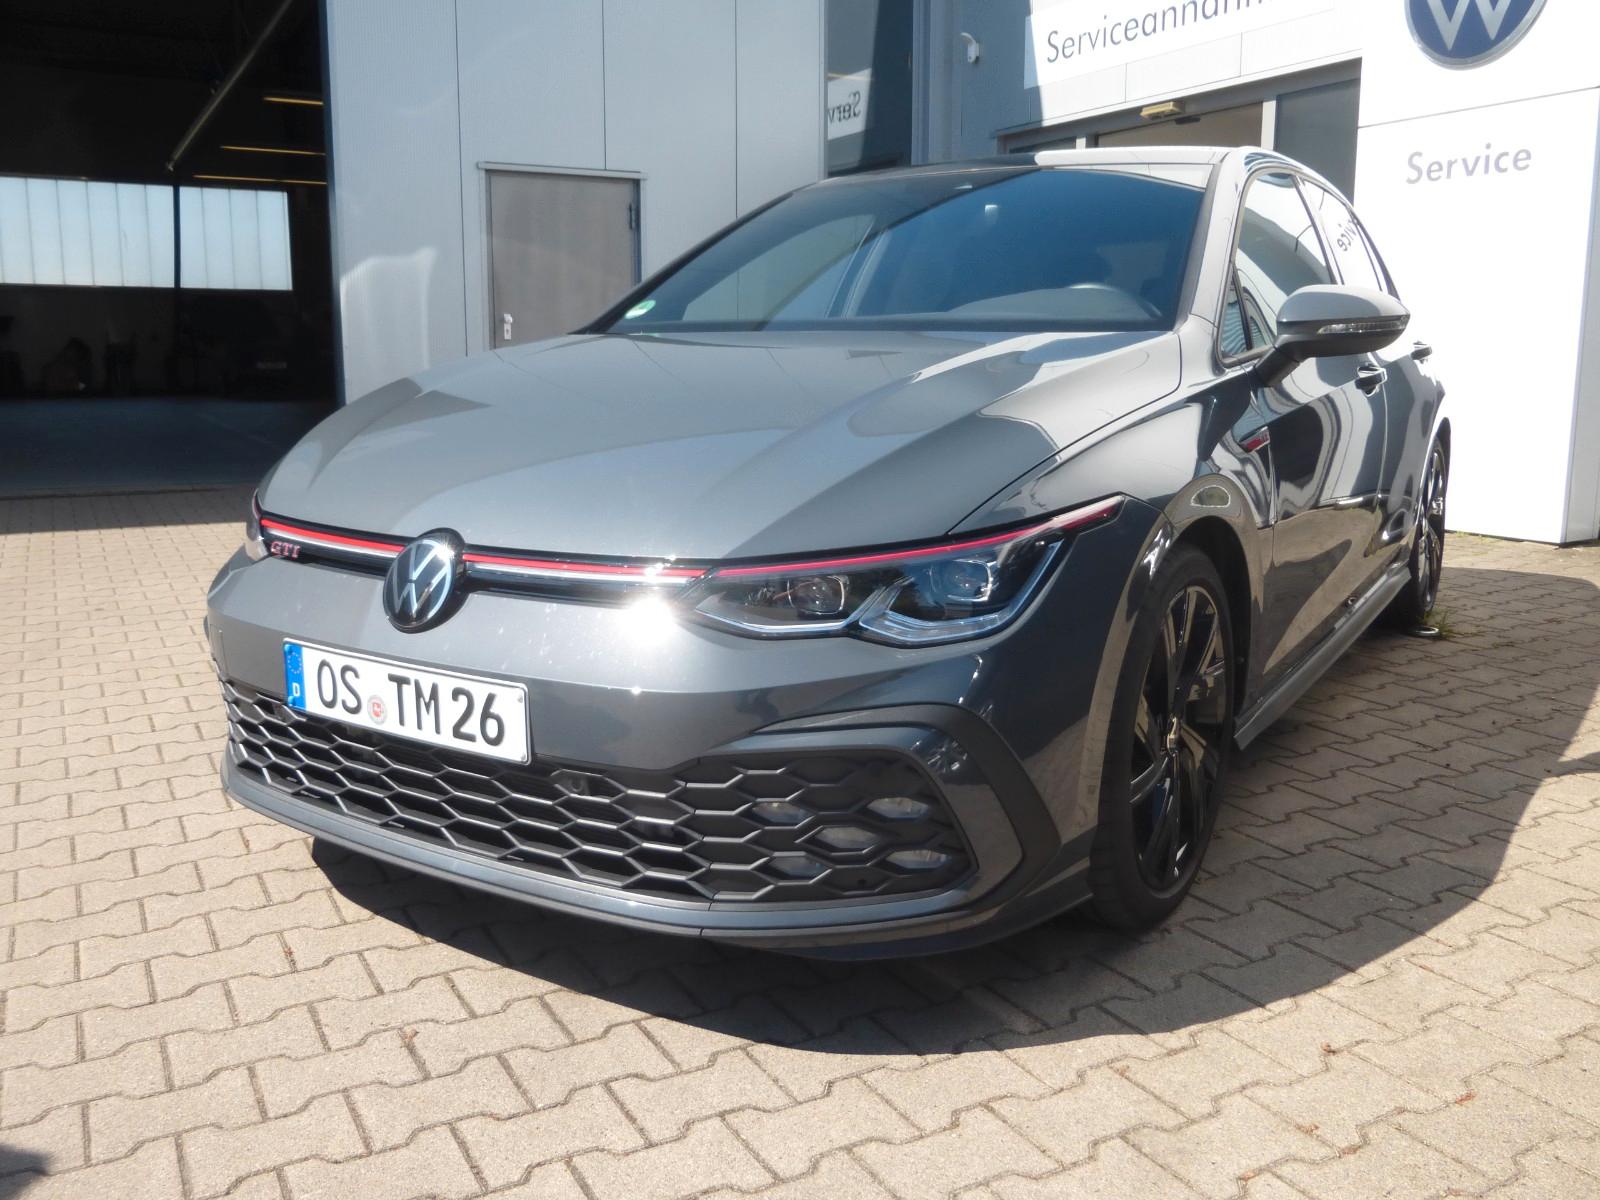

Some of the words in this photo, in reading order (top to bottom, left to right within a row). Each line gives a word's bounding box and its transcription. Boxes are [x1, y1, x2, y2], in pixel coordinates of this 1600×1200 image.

[1047, 0, 1263, 63] Serviceanna
[1406, 142, 1532, 184] Service
[271, 541, 301, 559] GTI
[292, 682, 301, 697] D
[317, 659, 362, 715] OS
[387, 673, 442, 735] TM
[451, 687, 505, 747] 26
